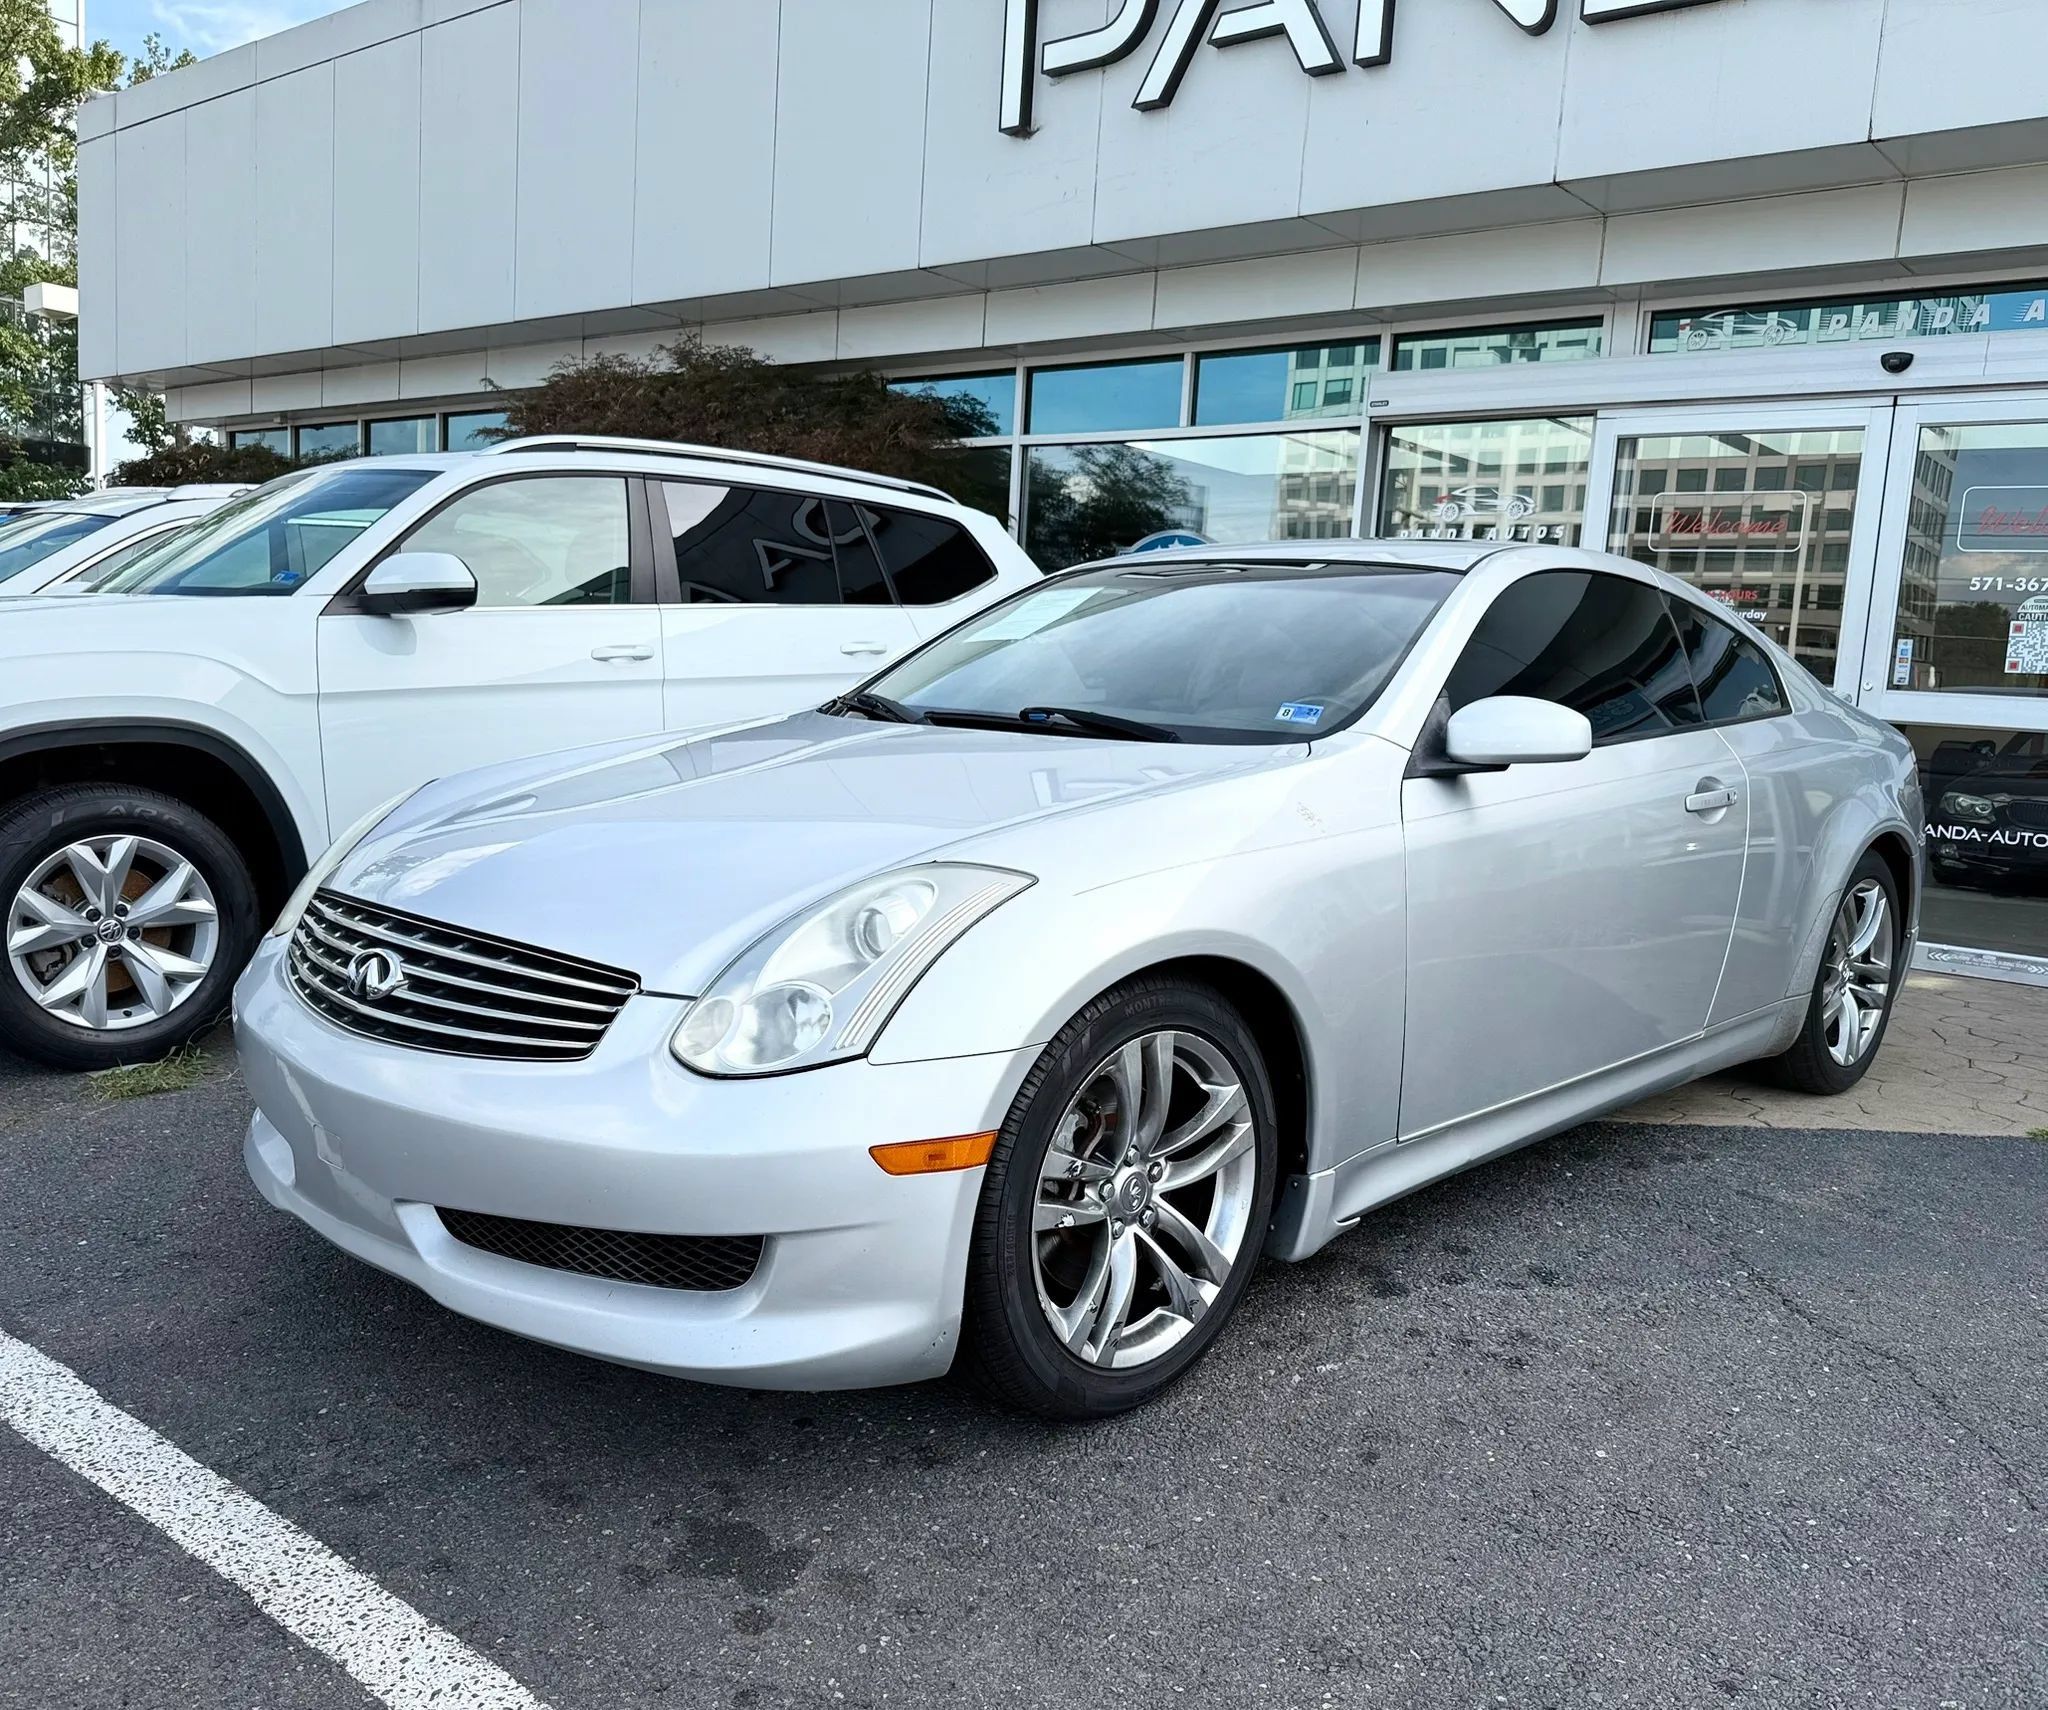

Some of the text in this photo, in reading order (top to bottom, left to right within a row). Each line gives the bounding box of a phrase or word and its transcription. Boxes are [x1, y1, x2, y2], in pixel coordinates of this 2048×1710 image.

[1826, 303, 1990, 335] PANDA
[1666, 509, 1788, 536] Welcome
[1485, 525, 1565, 541] AUTOS
[1735, 609, 1767, 621] urday
[2018, 613, 2048, 621] CAUTI
[1924, 823, 2048, 848] ANDA-AUTO
